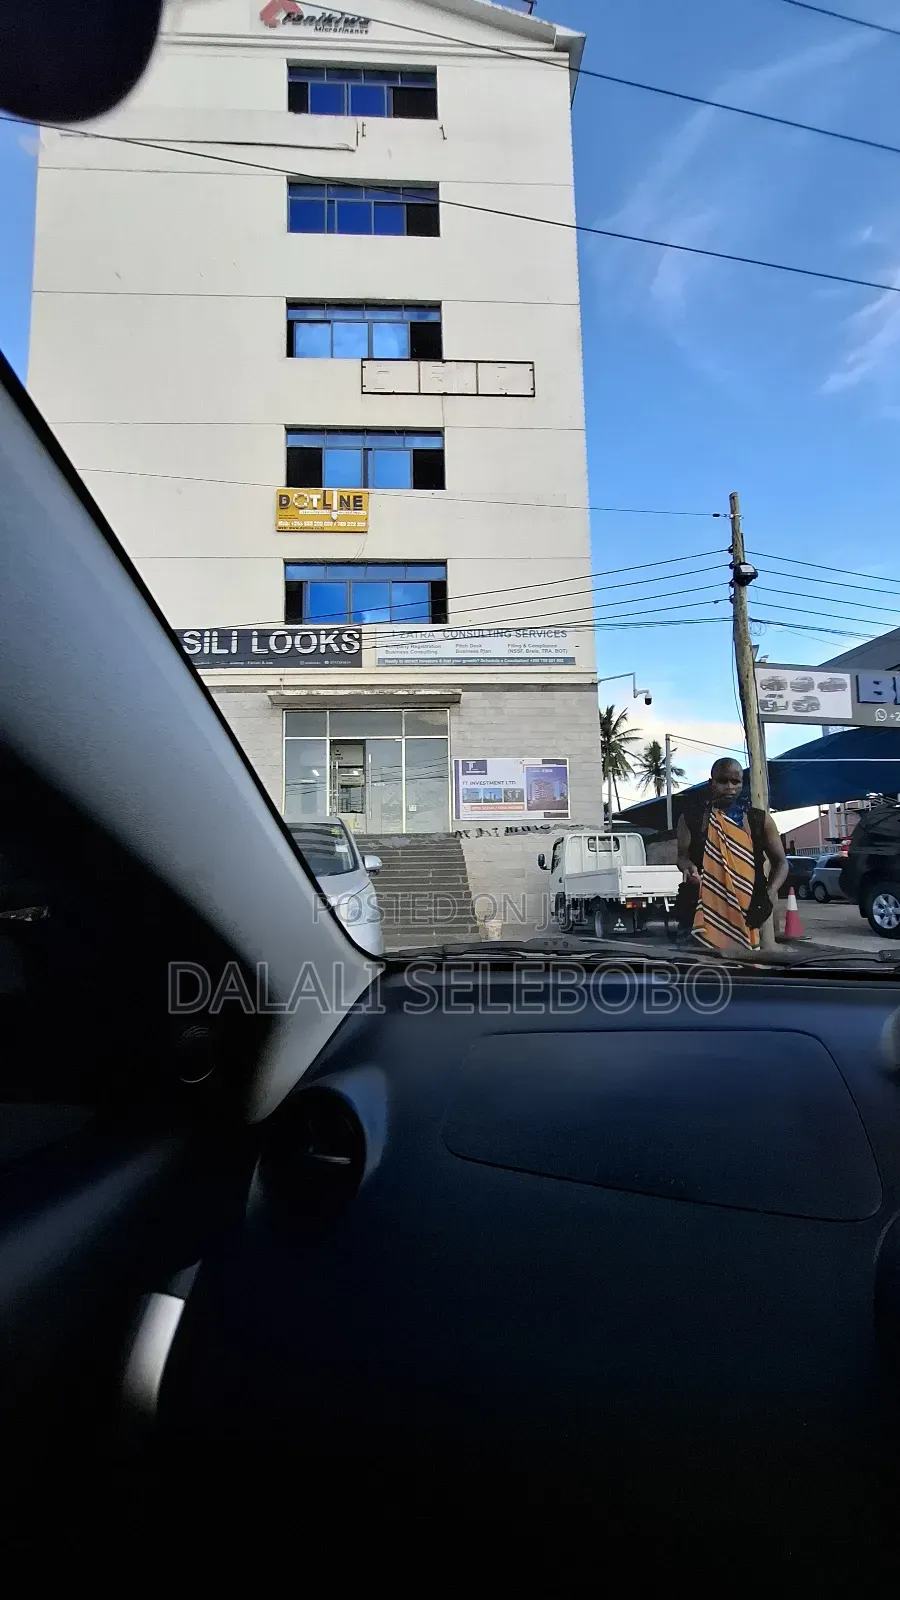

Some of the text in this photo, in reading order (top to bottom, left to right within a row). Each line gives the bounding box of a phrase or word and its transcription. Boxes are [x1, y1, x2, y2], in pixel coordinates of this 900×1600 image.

[279, 490, 363, 512] DOTLINE
[182, 630, 360, 655] SILI LOOKS
[515, 629, 567, 638] SERVICES
